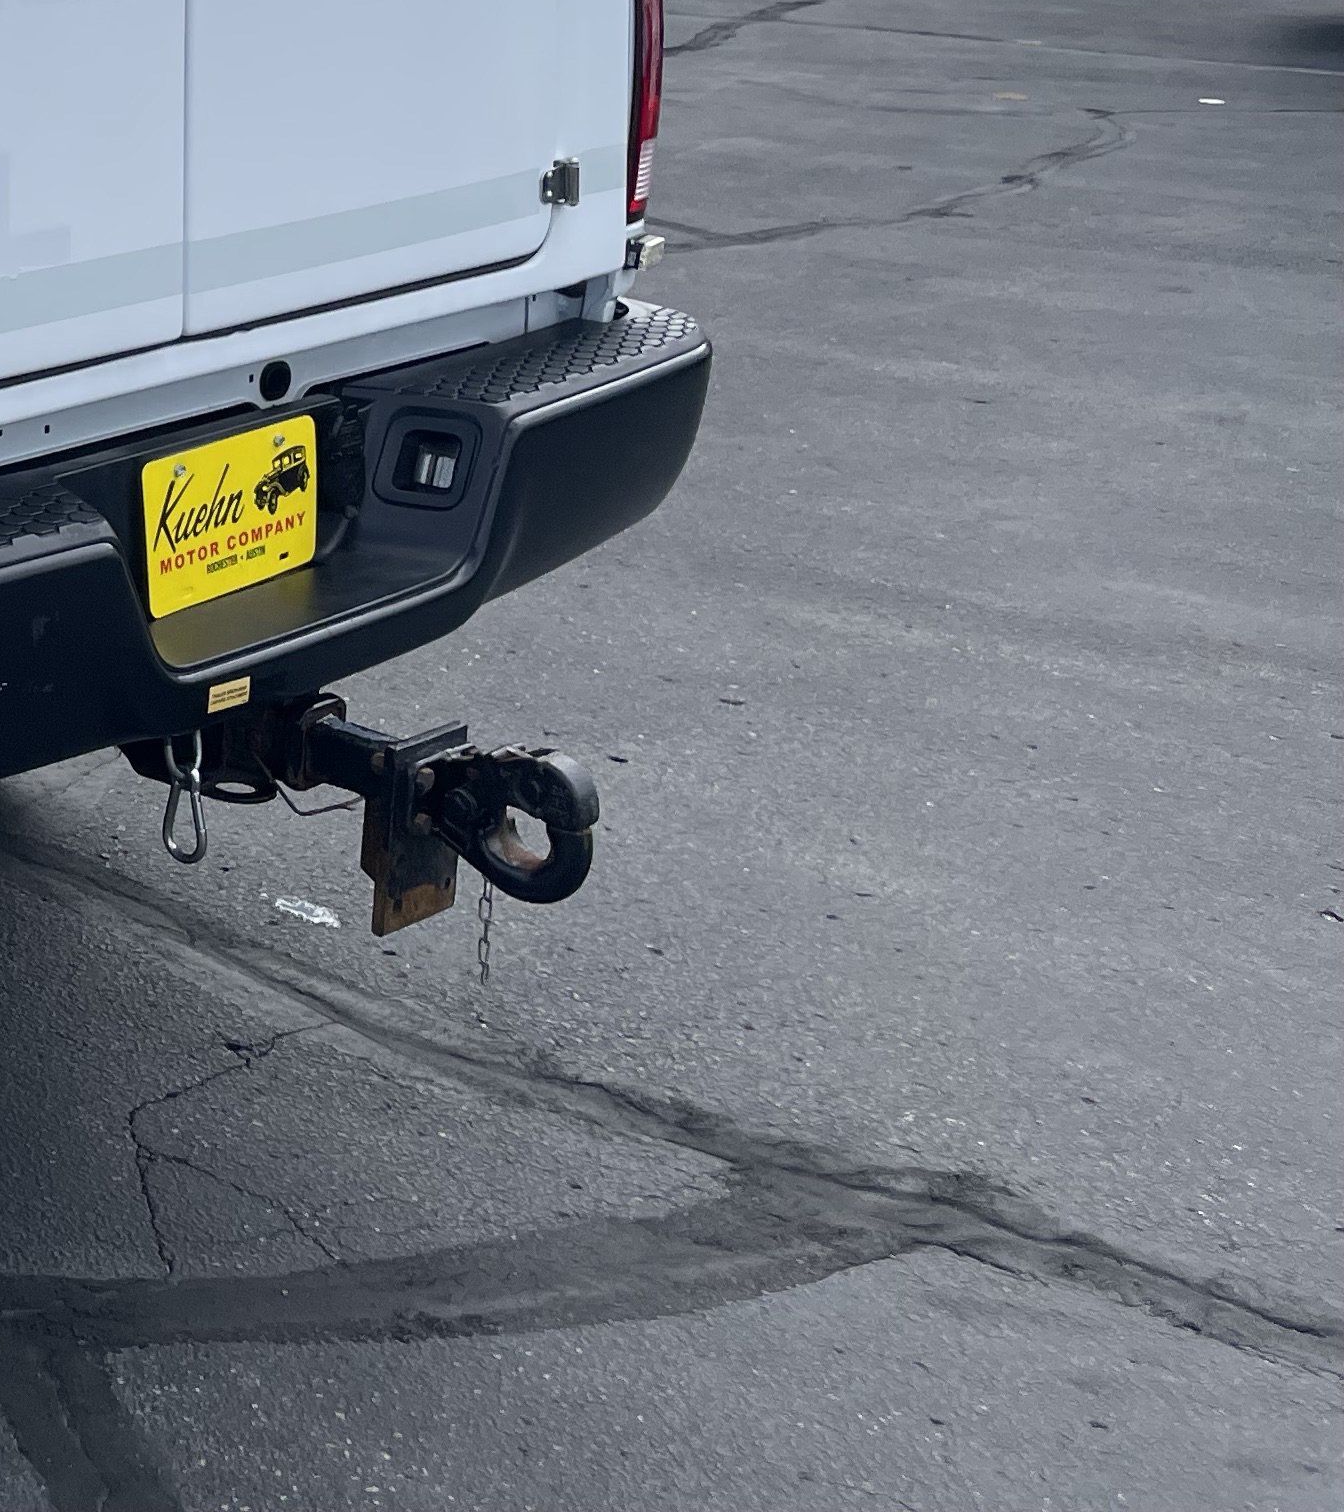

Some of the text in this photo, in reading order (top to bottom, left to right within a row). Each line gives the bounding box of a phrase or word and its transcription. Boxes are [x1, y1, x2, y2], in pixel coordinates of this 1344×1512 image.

[152, 463, 246, 554] Kuehn
[158, 510, 307, 576] MOTOR COMPANY
